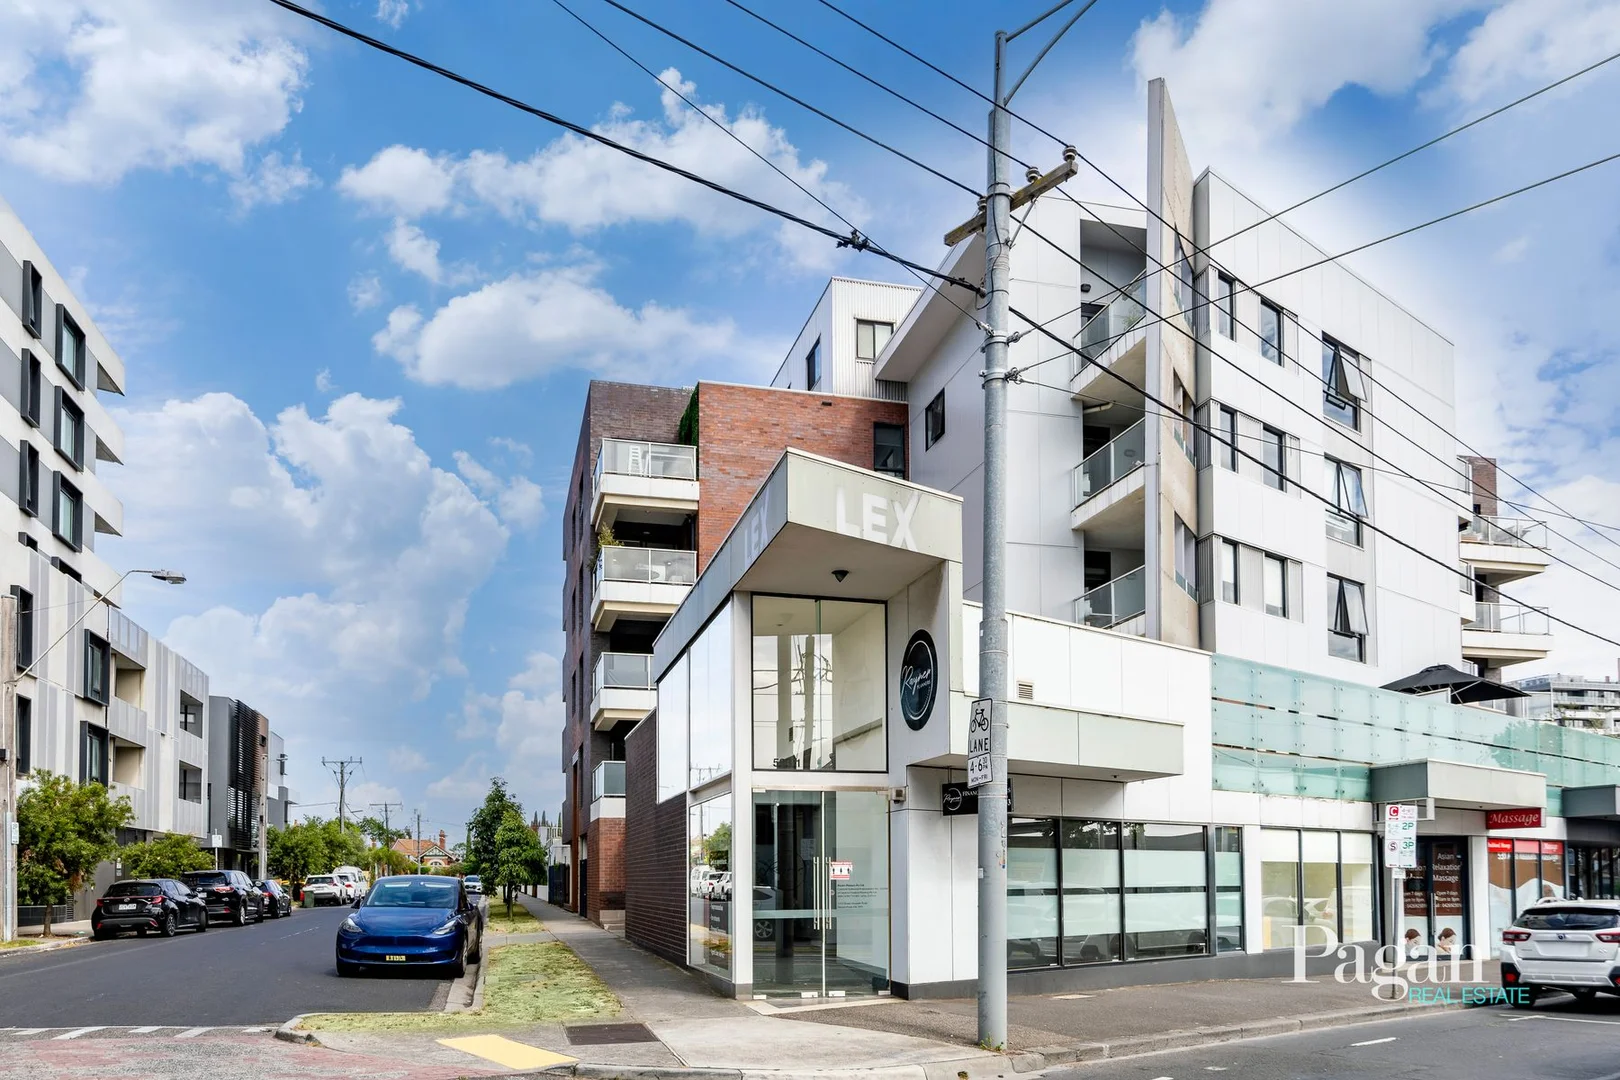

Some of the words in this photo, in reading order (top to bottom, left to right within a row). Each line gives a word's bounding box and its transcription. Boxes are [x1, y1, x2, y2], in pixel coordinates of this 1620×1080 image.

[836, 485, 921, 552] LEX
[744, 487, 770, 568] LEX
[969, 737, 989, 753] LANE
[969, 758, 983, 774] 4-6
[1390, 806, 1398, 816] C
[1489, 813, 1539, 826] Massage
[1402, 822, 1414, 830] 2P
[1390, 842, 1396, 851] S
[1402, 841, 1414, 850] 3P
[1432, 874, 1459, 884] Massage
